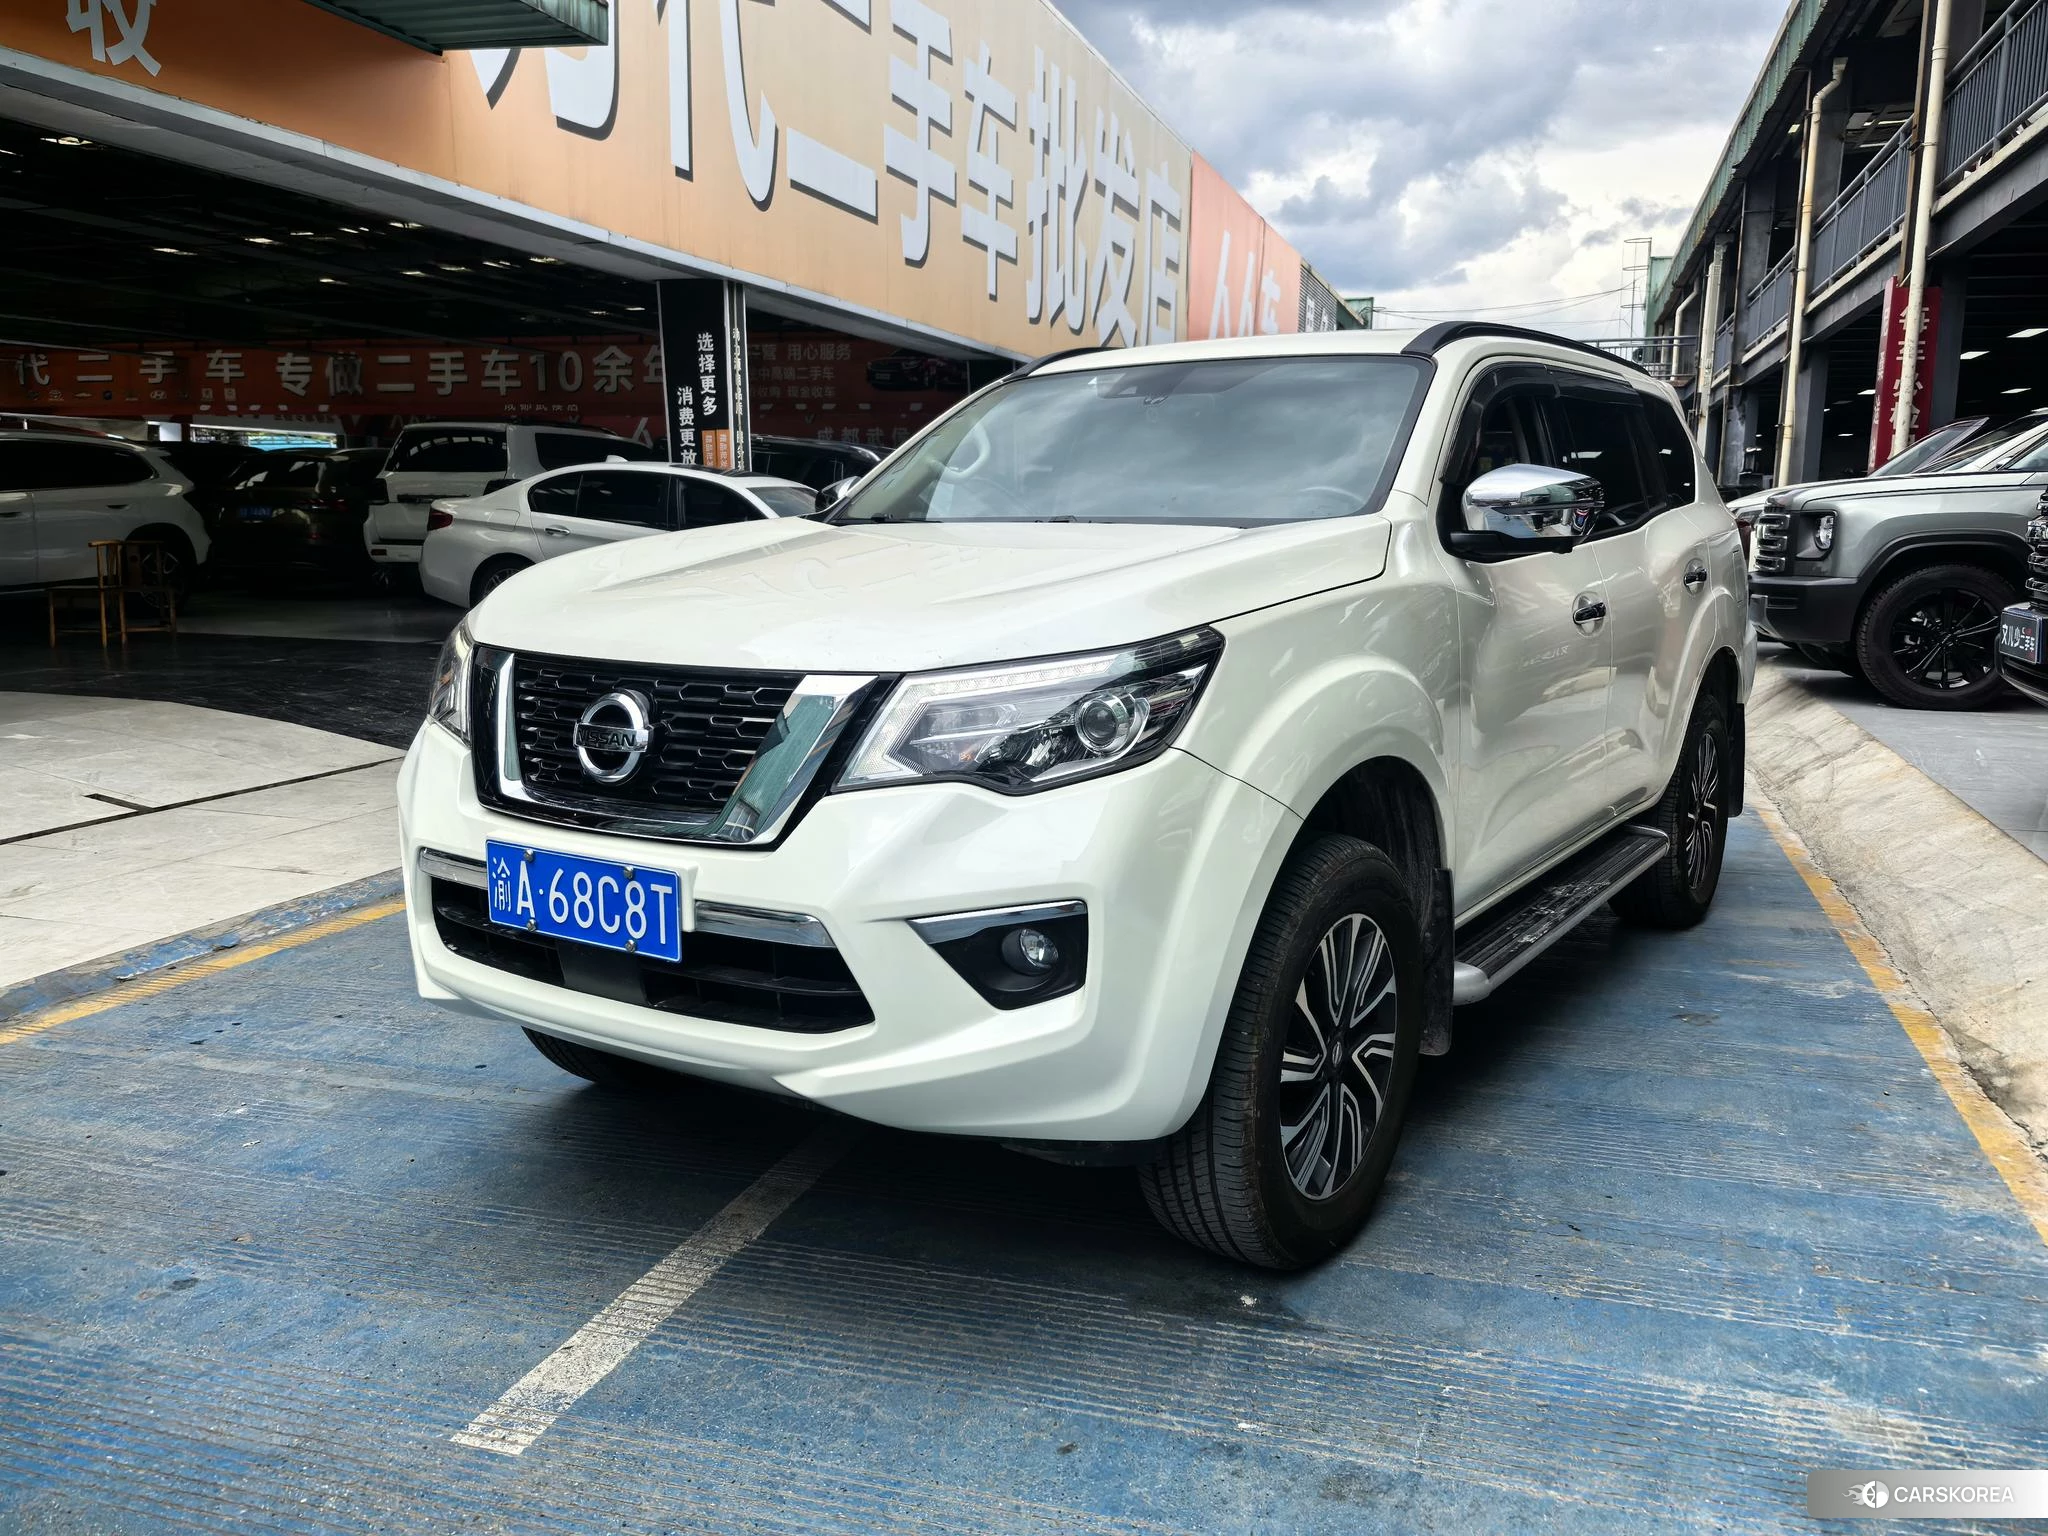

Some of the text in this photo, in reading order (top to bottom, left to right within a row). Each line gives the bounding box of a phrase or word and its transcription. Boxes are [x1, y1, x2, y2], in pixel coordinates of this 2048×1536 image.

[697, 331, 718, 417] 选择更多
[787, 343, 852, 361] 用心服务
[677, 386, 698, 465] 消费更放
[576, 729, 636, 747] NISSAN
